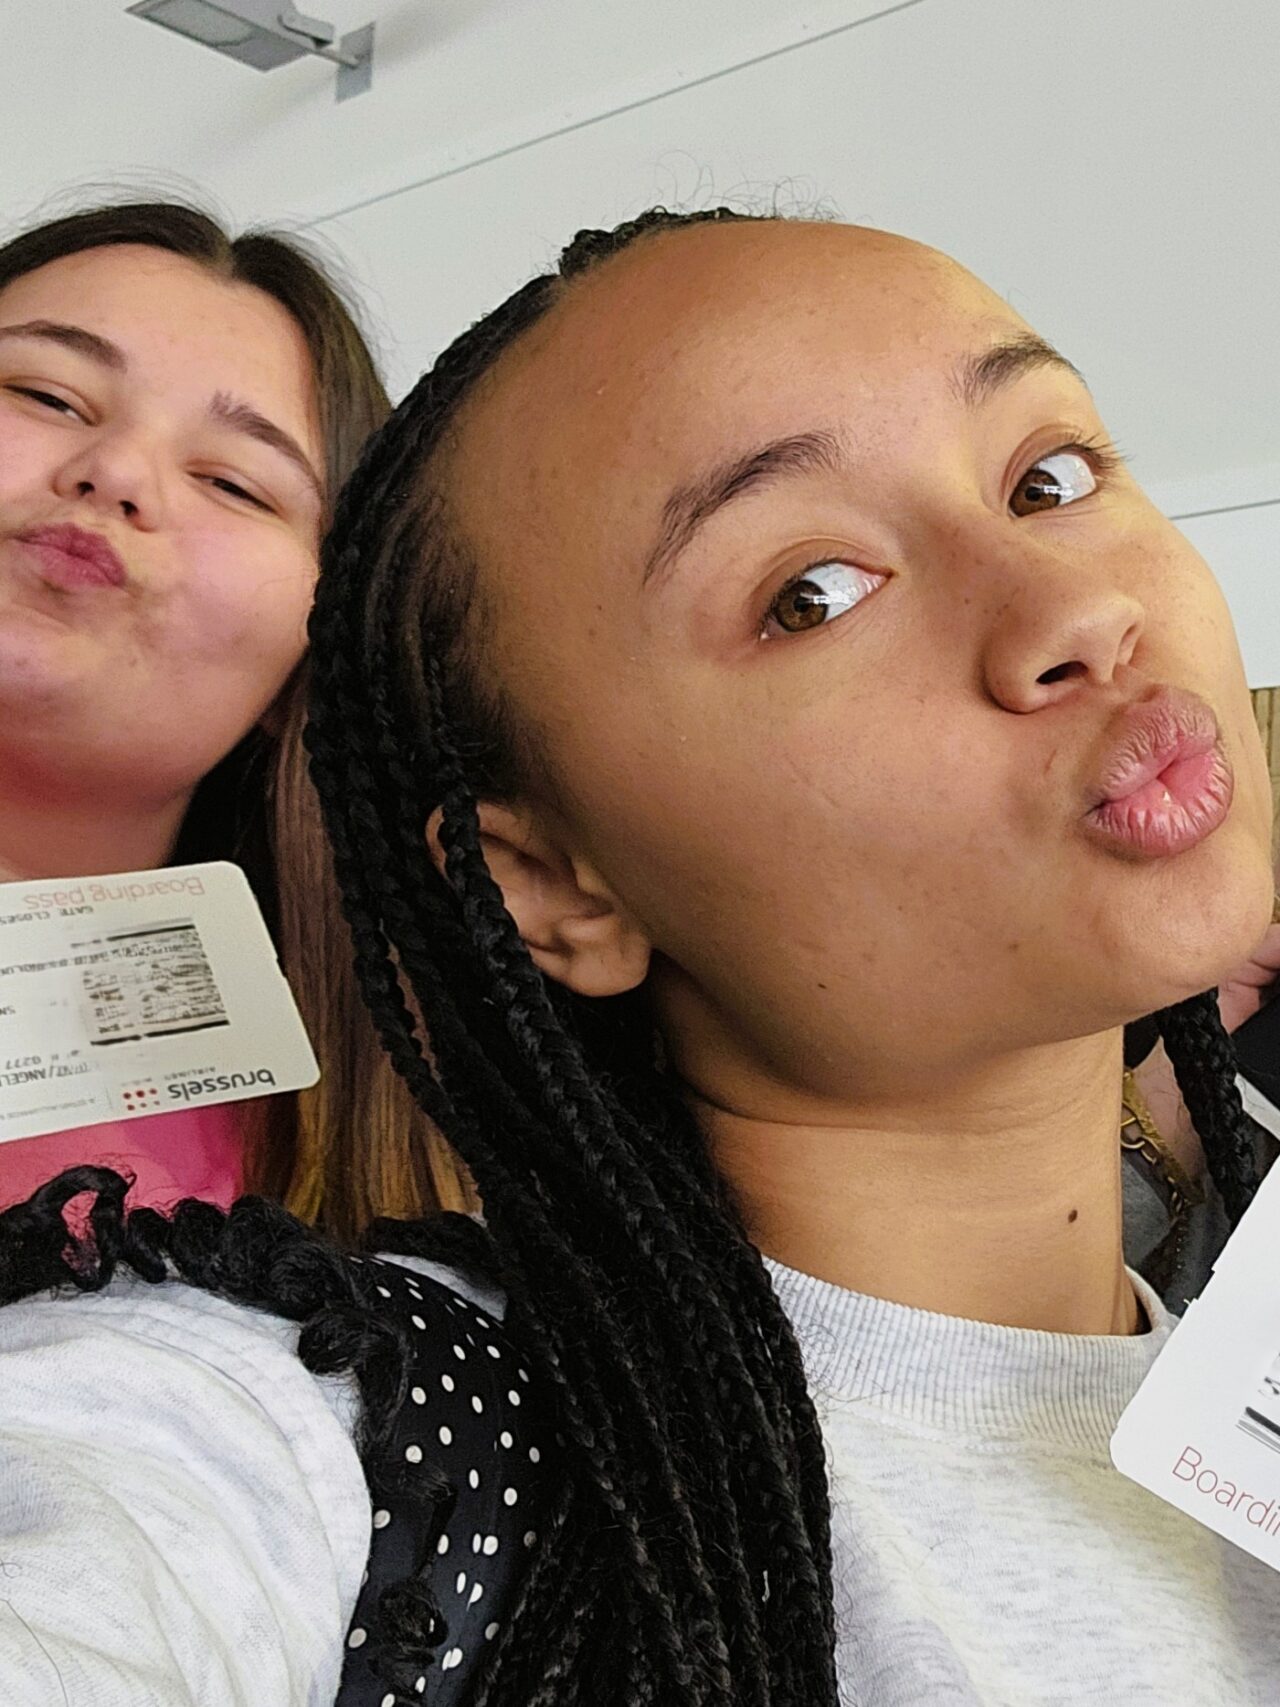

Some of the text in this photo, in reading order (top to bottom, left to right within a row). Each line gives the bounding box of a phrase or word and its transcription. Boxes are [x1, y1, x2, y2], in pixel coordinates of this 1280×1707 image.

[22, 875, 204, 910] Boarding pass
[166, 1067, 275, 1103] brussels
